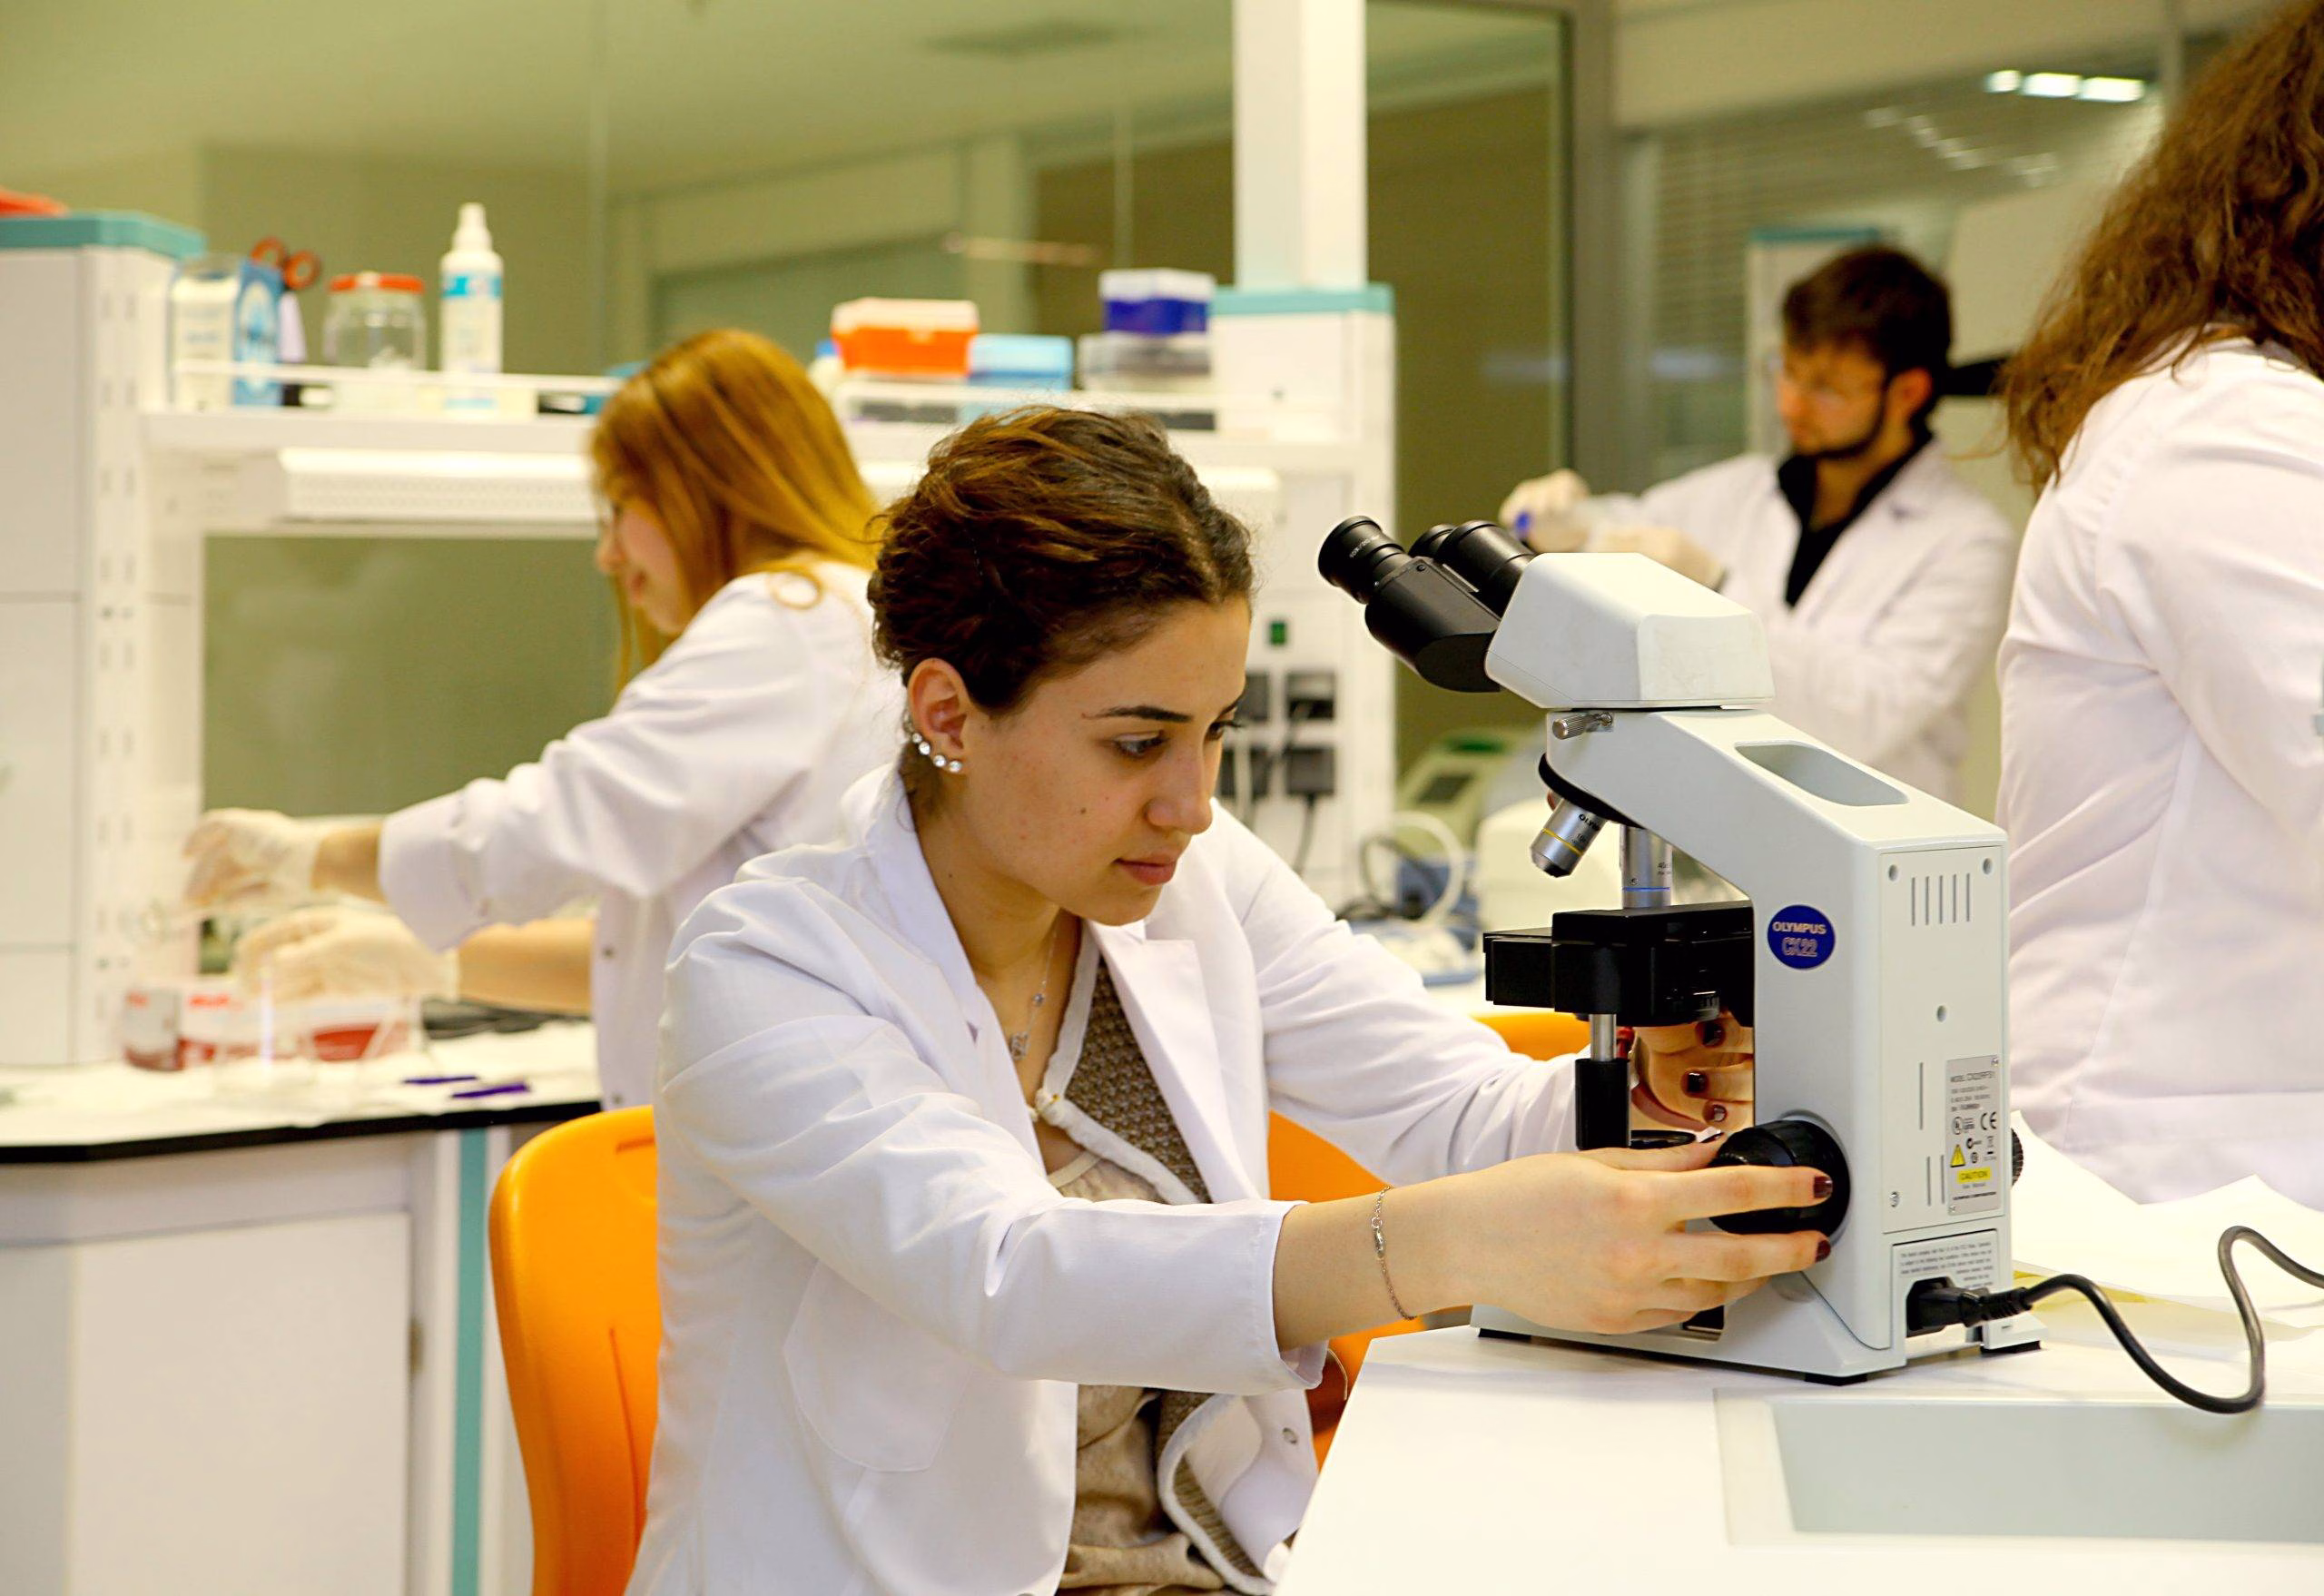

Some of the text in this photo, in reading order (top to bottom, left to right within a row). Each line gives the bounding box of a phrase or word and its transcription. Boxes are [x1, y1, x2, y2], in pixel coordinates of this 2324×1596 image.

[1772, 921, 1827, 934] OLYMPUS
[1782, 937, 1817, 957] CX22
[1960, 1170, 1988, 1181] CAUTION
